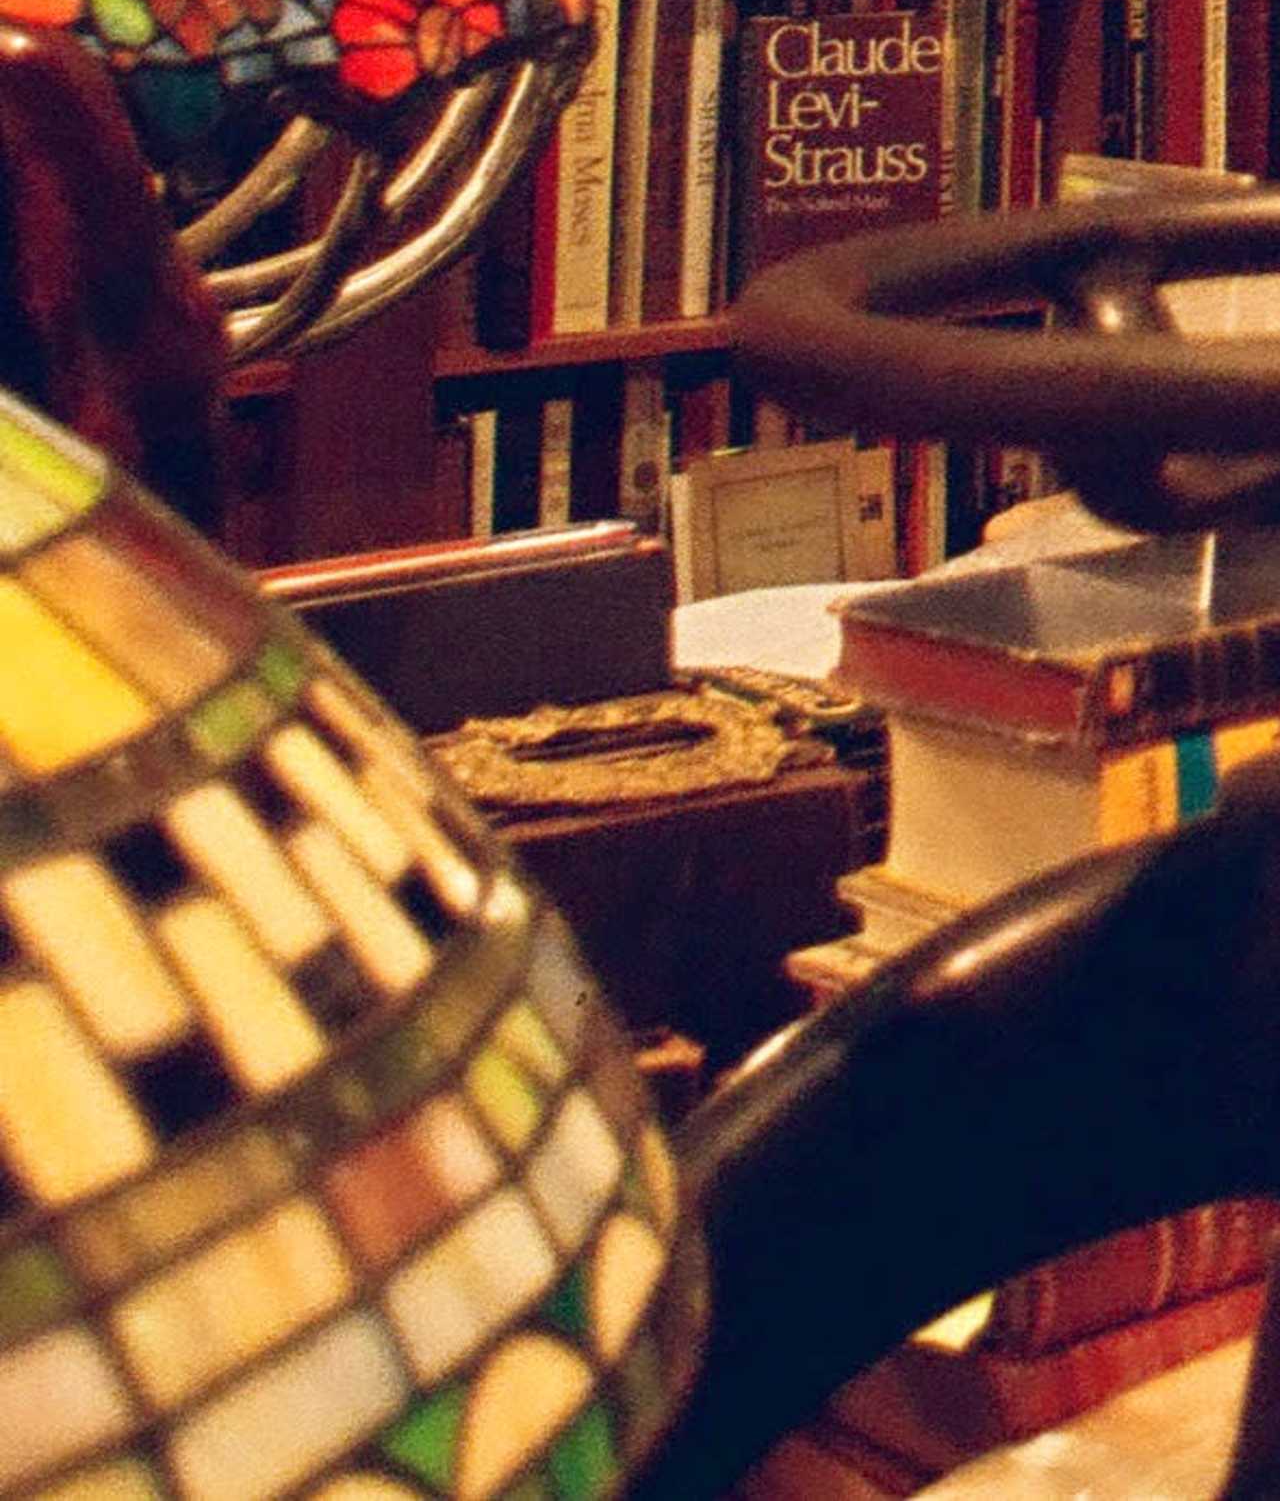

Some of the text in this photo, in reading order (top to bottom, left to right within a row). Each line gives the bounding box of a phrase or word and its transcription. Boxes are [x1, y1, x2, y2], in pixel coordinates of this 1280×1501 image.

[767, 19, 942, 79] Claude
[697, 90, 719, 186] SHAKER
[764, 133, 929, 188] Strauss
[570, 155, 606, 247] Moses
